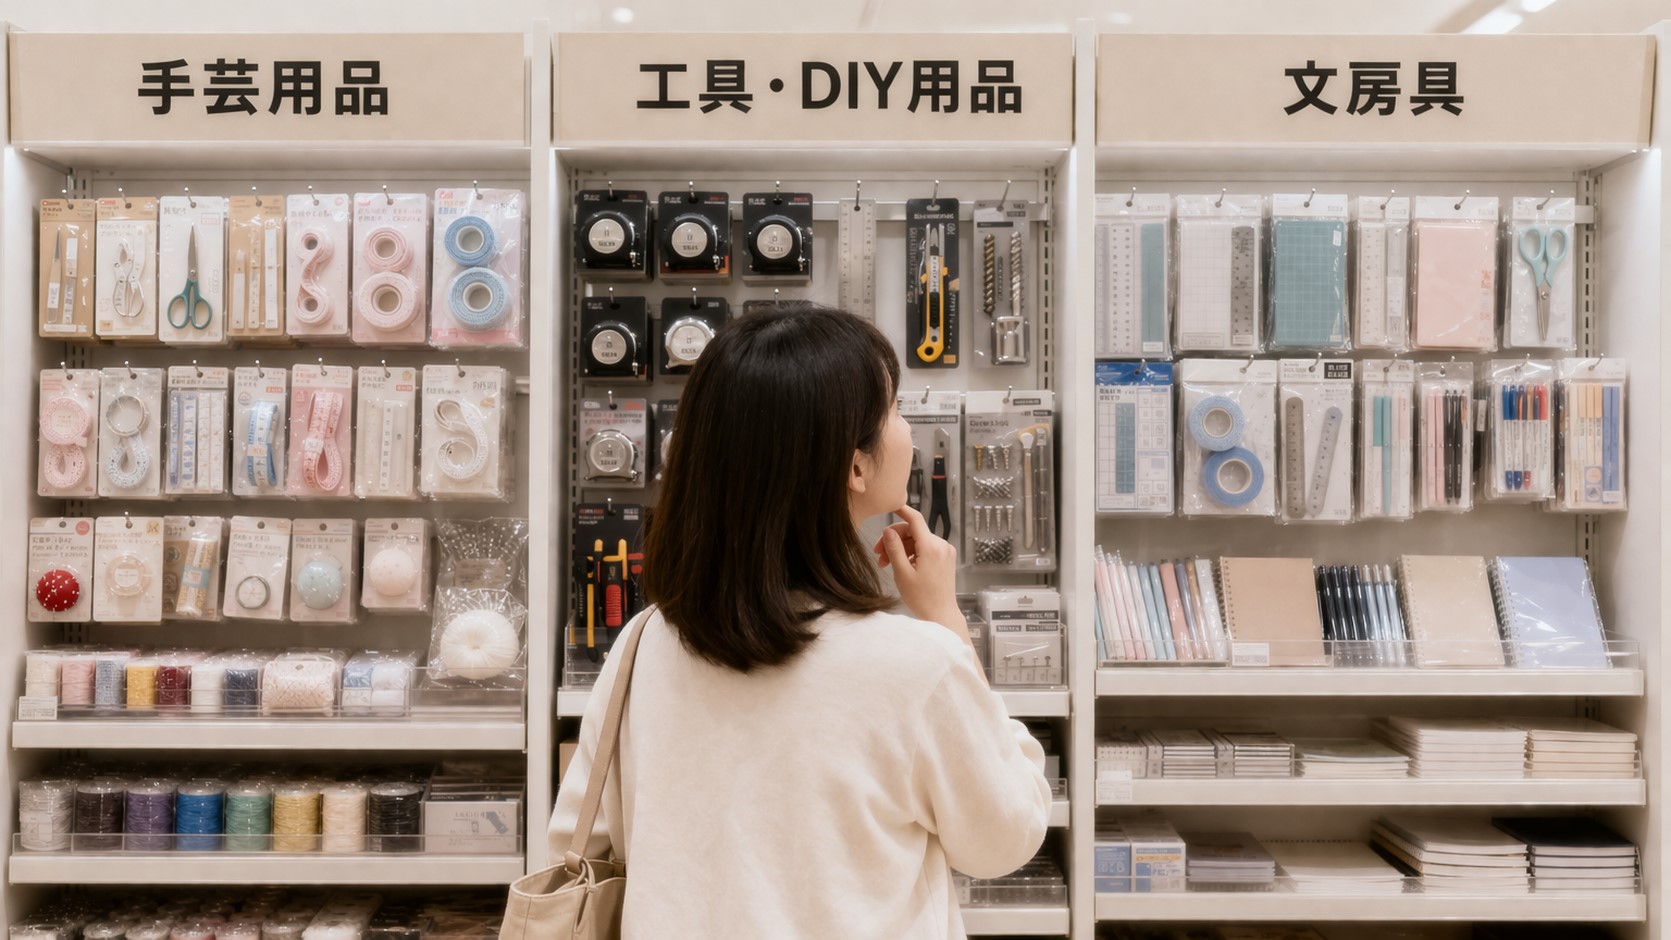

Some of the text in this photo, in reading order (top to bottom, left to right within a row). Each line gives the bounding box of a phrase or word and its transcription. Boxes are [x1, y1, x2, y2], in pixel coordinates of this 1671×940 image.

[138, 59, 388, 115] 手芸用品
[637, 60, 1022, 114] 工具・DIY用品
[1284, 61, 1464, 116] 文房具
